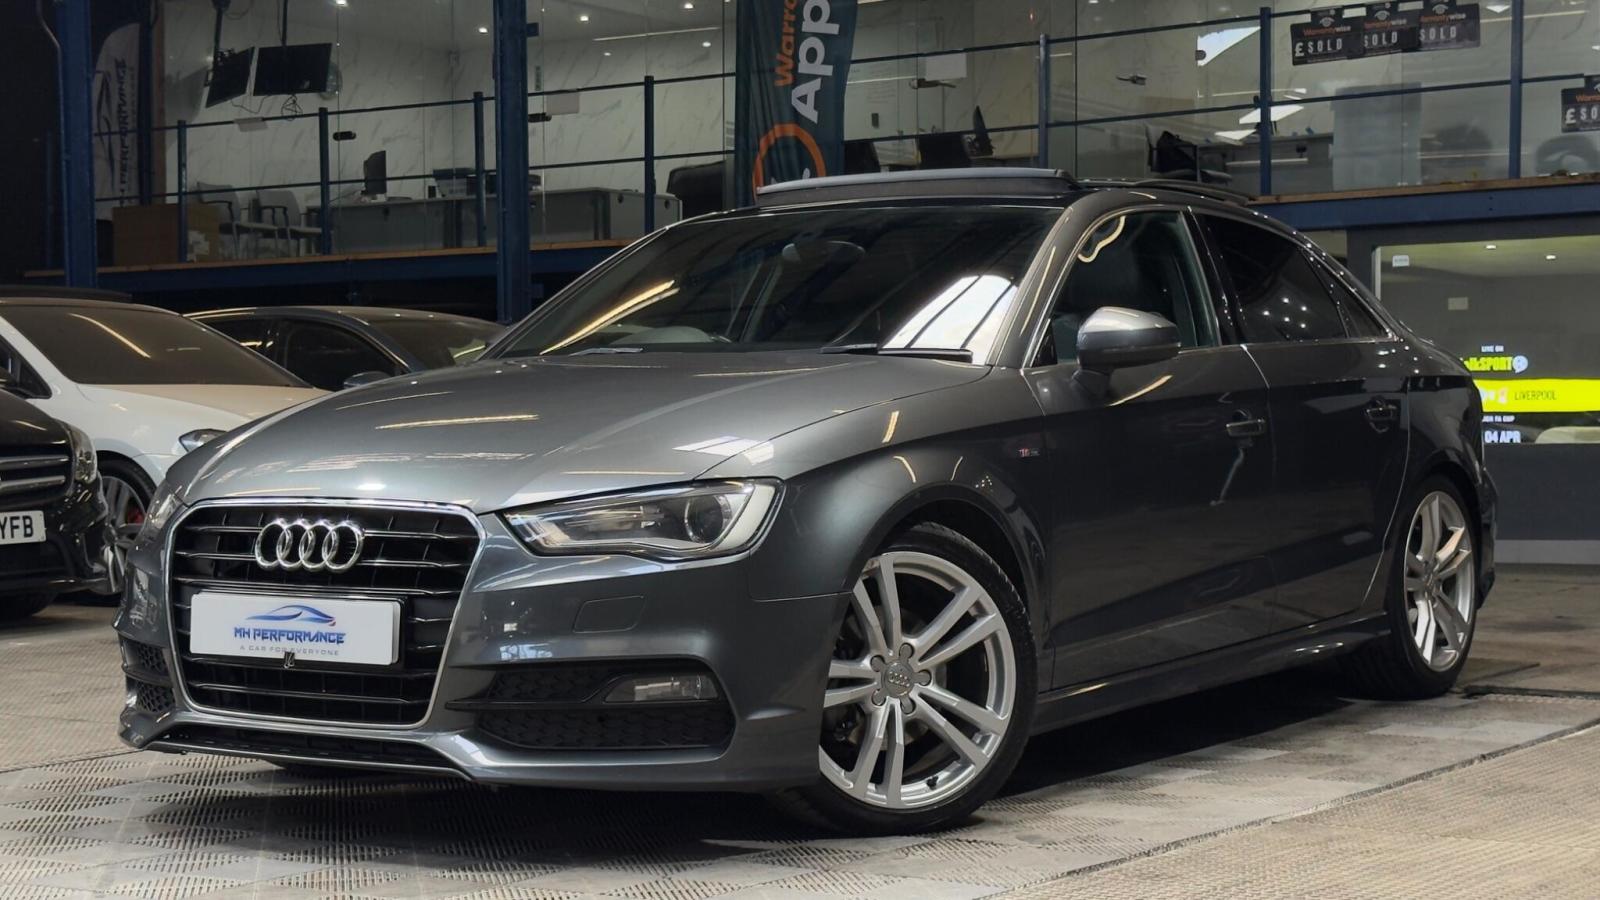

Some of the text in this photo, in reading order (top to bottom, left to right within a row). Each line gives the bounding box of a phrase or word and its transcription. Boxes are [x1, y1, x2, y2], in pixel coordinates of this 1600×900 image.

[1363, 31, 1398, 48] SOLD
[1419, 26, 1457, 41] SOLD
[791, 0, 840, 124] App
[1514, 390, 1558, 401] LIVERPOOL
[252, 628, 346, 645] PERFORMANCE
